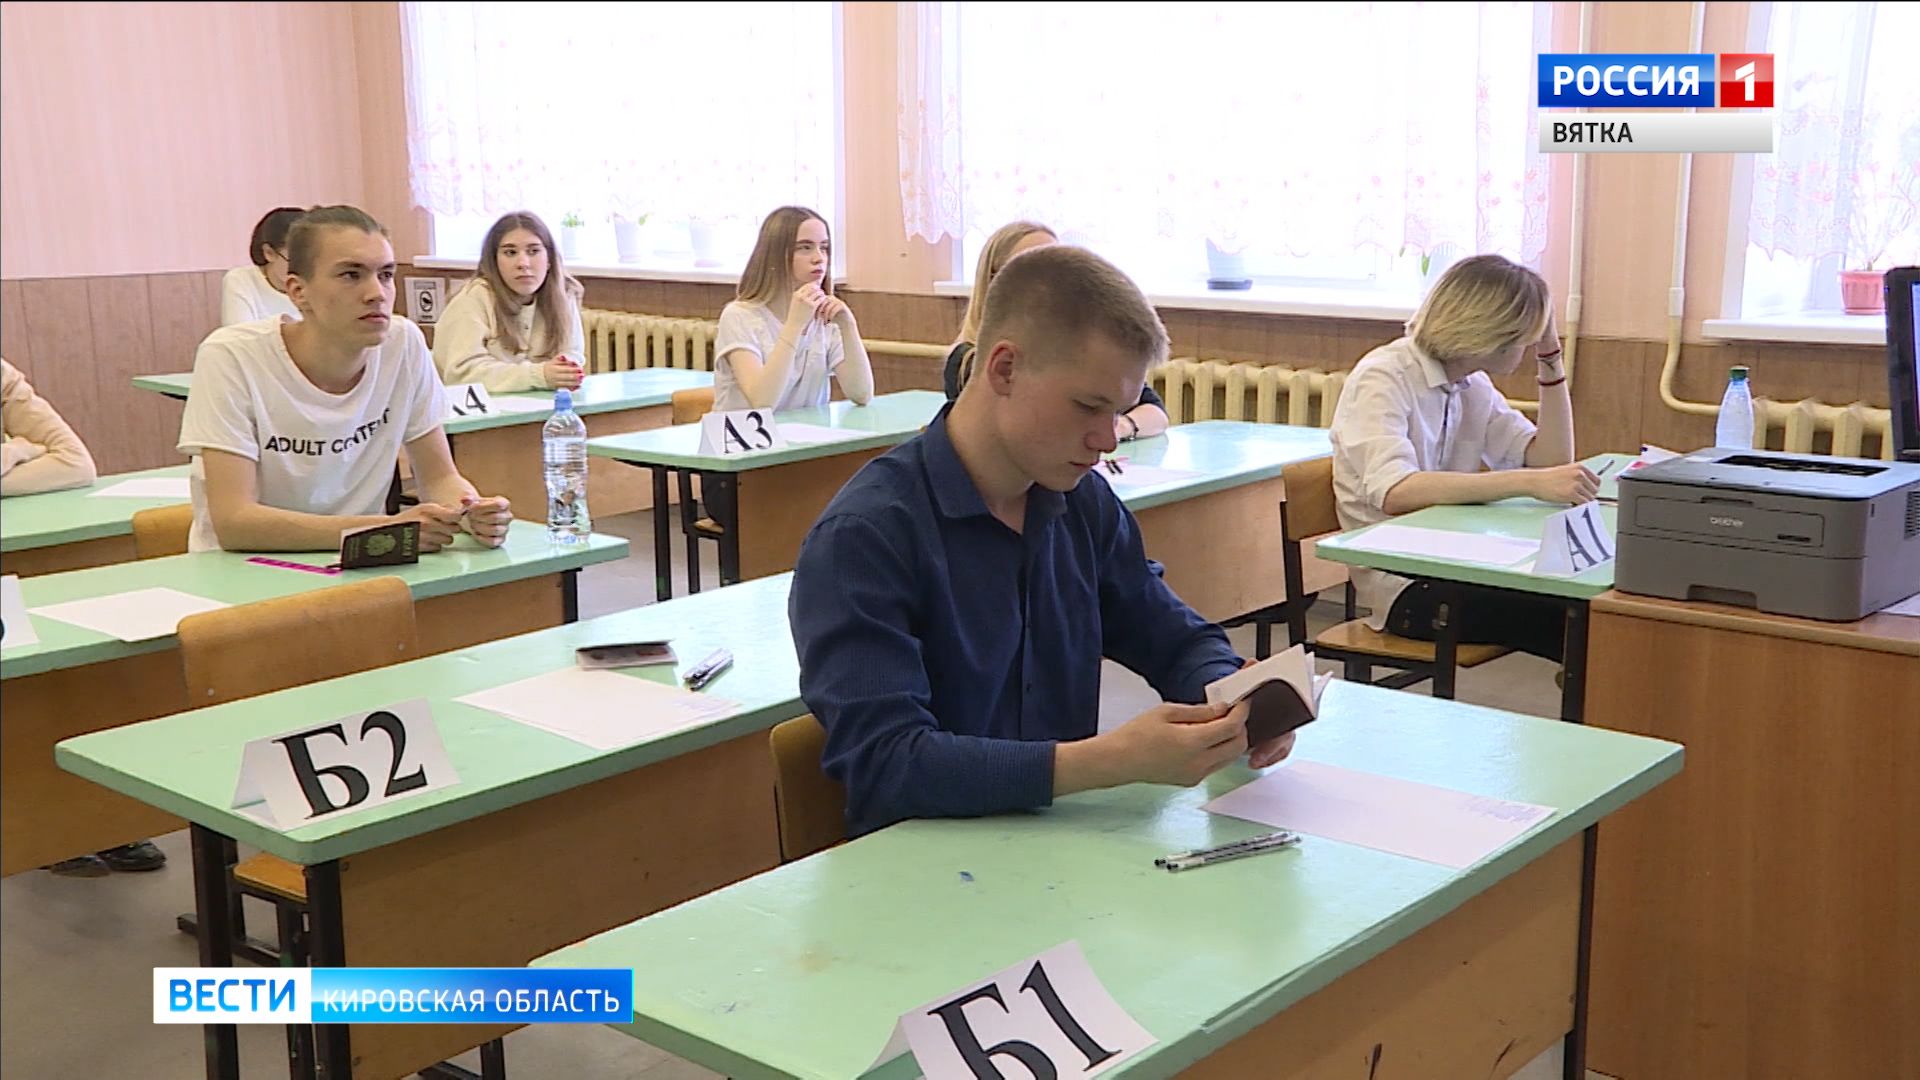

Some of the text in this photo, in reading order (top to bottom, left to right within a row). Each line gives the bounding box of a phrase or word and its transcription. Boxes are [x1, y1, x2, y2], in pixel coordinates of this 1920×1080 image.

[265, 435, 326, 456] ADULT
[723, 411, 773, 455] А3
[1565, 506, 1614, 573] А1
[271, 711, 428, 819] Б2
[927, 959, 1123, 1080] Б1
